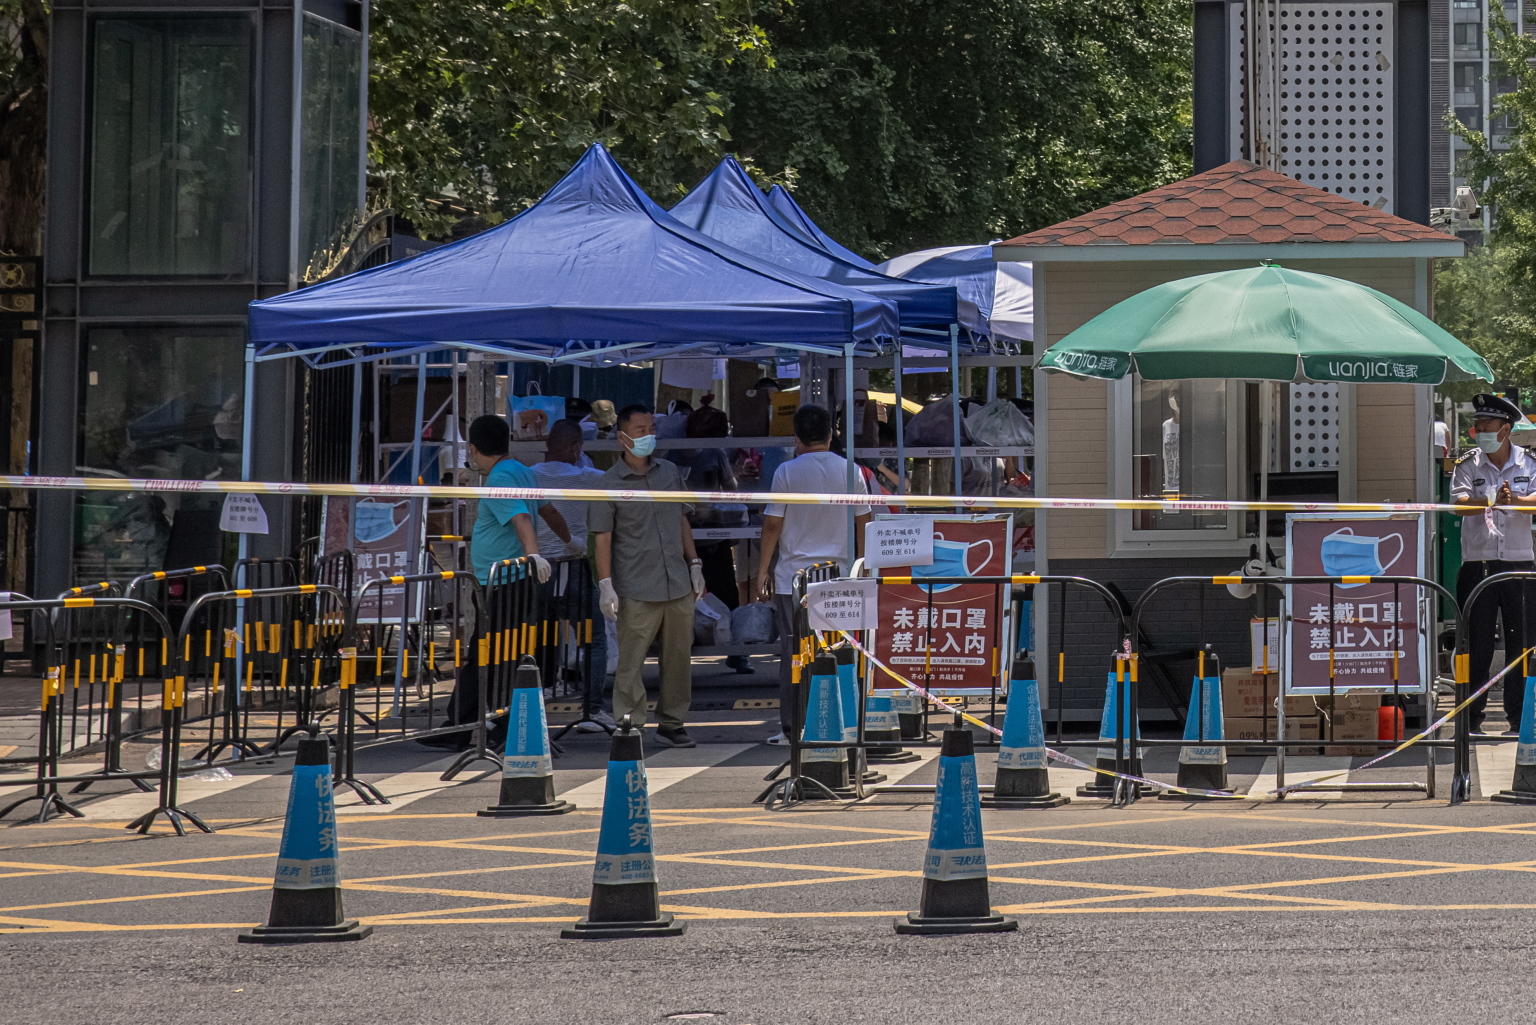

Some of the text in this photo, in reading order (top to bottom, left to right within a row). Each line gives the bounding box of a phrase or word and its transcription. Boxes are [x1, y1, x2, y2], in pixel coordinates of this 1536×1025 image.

[876, 528, 921, 537] 外卖不喊单号
[880, 538, 917, 547] 按楼牌号分
[881, 548, 894, 556] 609
[904, 547, 916, 555] 614
[824, 599, 861, 608] 按楼牌号分
[848, 610, 860, 618] 614
[893, 607, 986, 629] 未戴口罩
[1309, 602, 1403, 624] 未戴口罩
[891, 632, 986, 654] 禁止入内
[1310, 626, 1404, 649] 禁止入内
[960, 761, 976, 845] 高新技术认证
